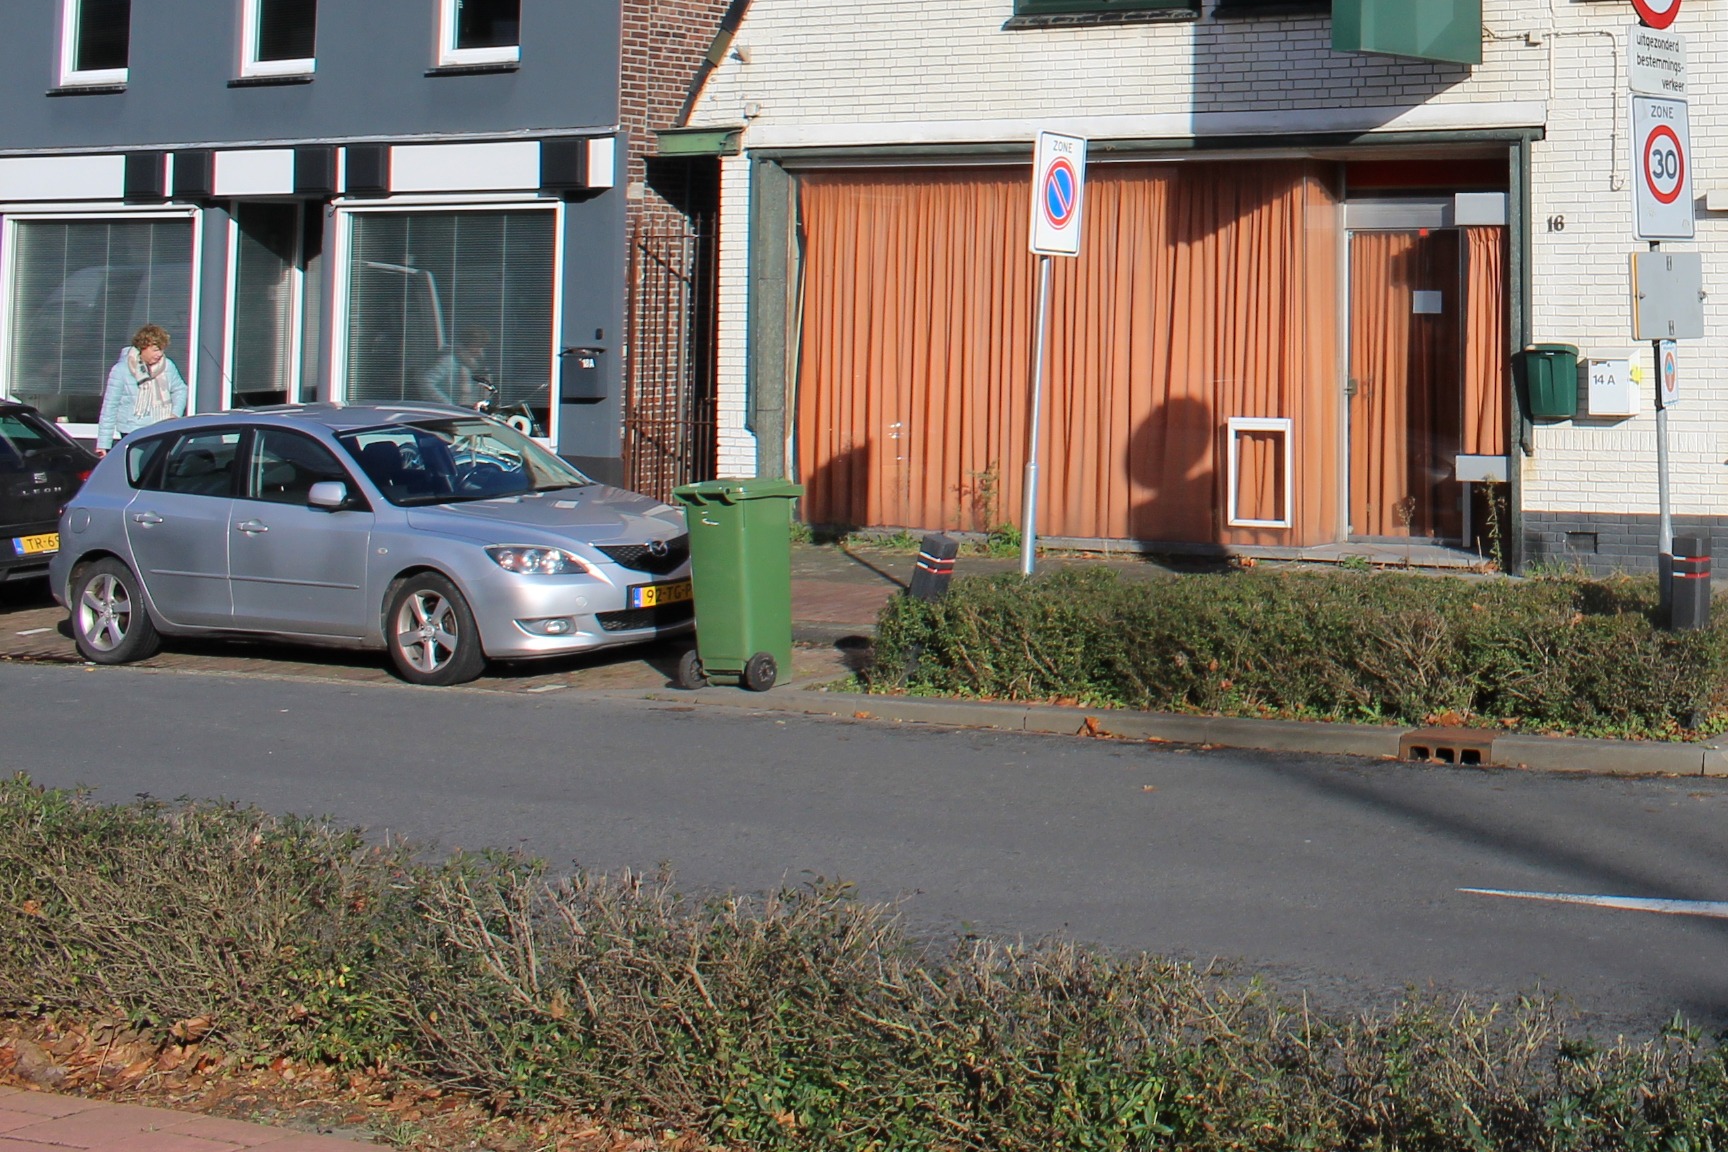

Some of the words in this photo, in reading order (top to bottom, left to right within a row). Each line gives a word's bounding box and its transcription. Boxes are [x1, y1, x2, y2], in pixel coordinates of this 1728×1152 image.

[1636, 33, 1680, 52] uitgezonderd
[1637, 52, 1684, 76] bestemmings-
[1661, 78, 1685, 92] verkeer
[1651, 105, 1674, 119] ZONE
[1053, 140, 1073, 154] ZONE
[1651, 149, 1678, 181] 30
[1547, 215, 1565, 232] 16
[1593, 374, 1604, 385] 14
[1607, 374, 1616, 385] A
